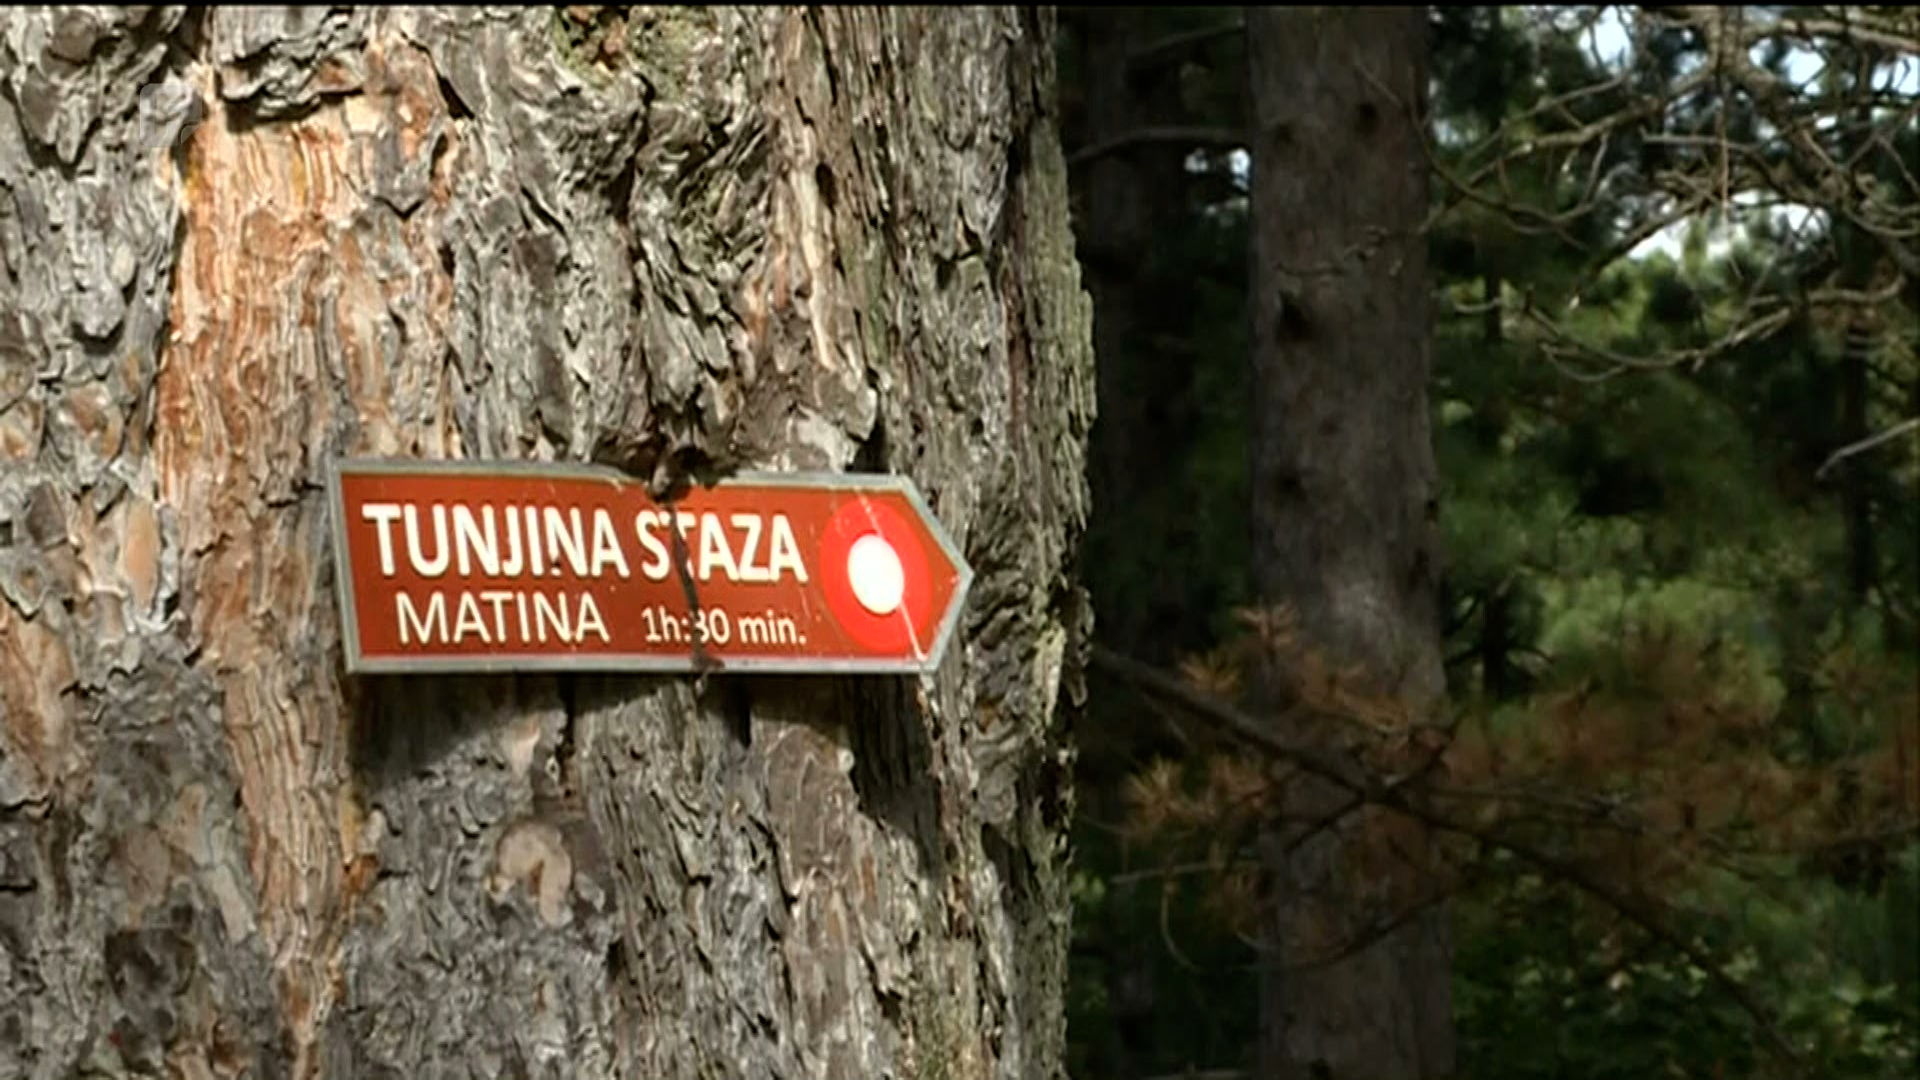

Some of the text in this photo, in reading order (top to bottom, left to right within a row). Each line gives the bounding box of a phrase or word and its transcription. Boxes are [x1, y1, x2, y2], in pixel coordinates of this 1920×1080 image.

[361, 503, 630, 577] TUNJINA
[395, 591, 611, 645] MATINA
[737, 609, 807, 645] min.
